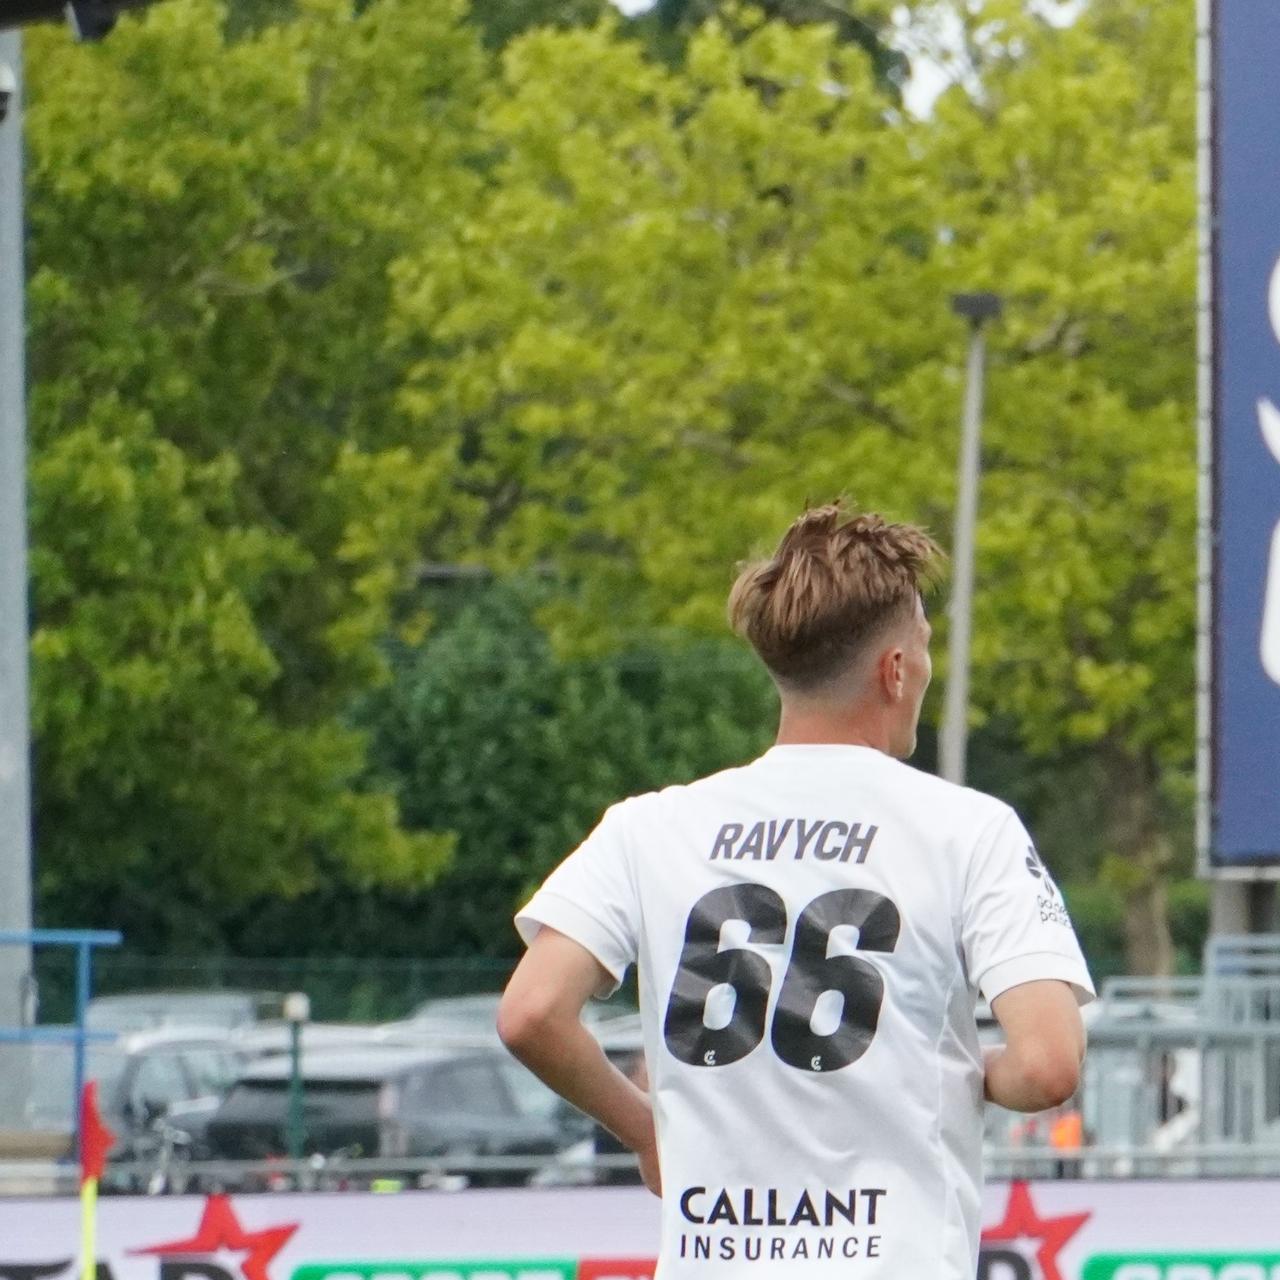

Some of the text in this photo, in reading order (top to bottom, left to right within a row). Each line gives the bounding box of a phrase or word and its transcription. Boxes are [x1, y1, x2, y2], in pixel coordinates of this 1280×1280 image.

[709, 819, 878, 864] RAVYCH
[664, 883, 901, 1072] 66
[680, 1186, 887, 1226] CALLANT
[680, 1234, 882, 1261] INSURANCE
